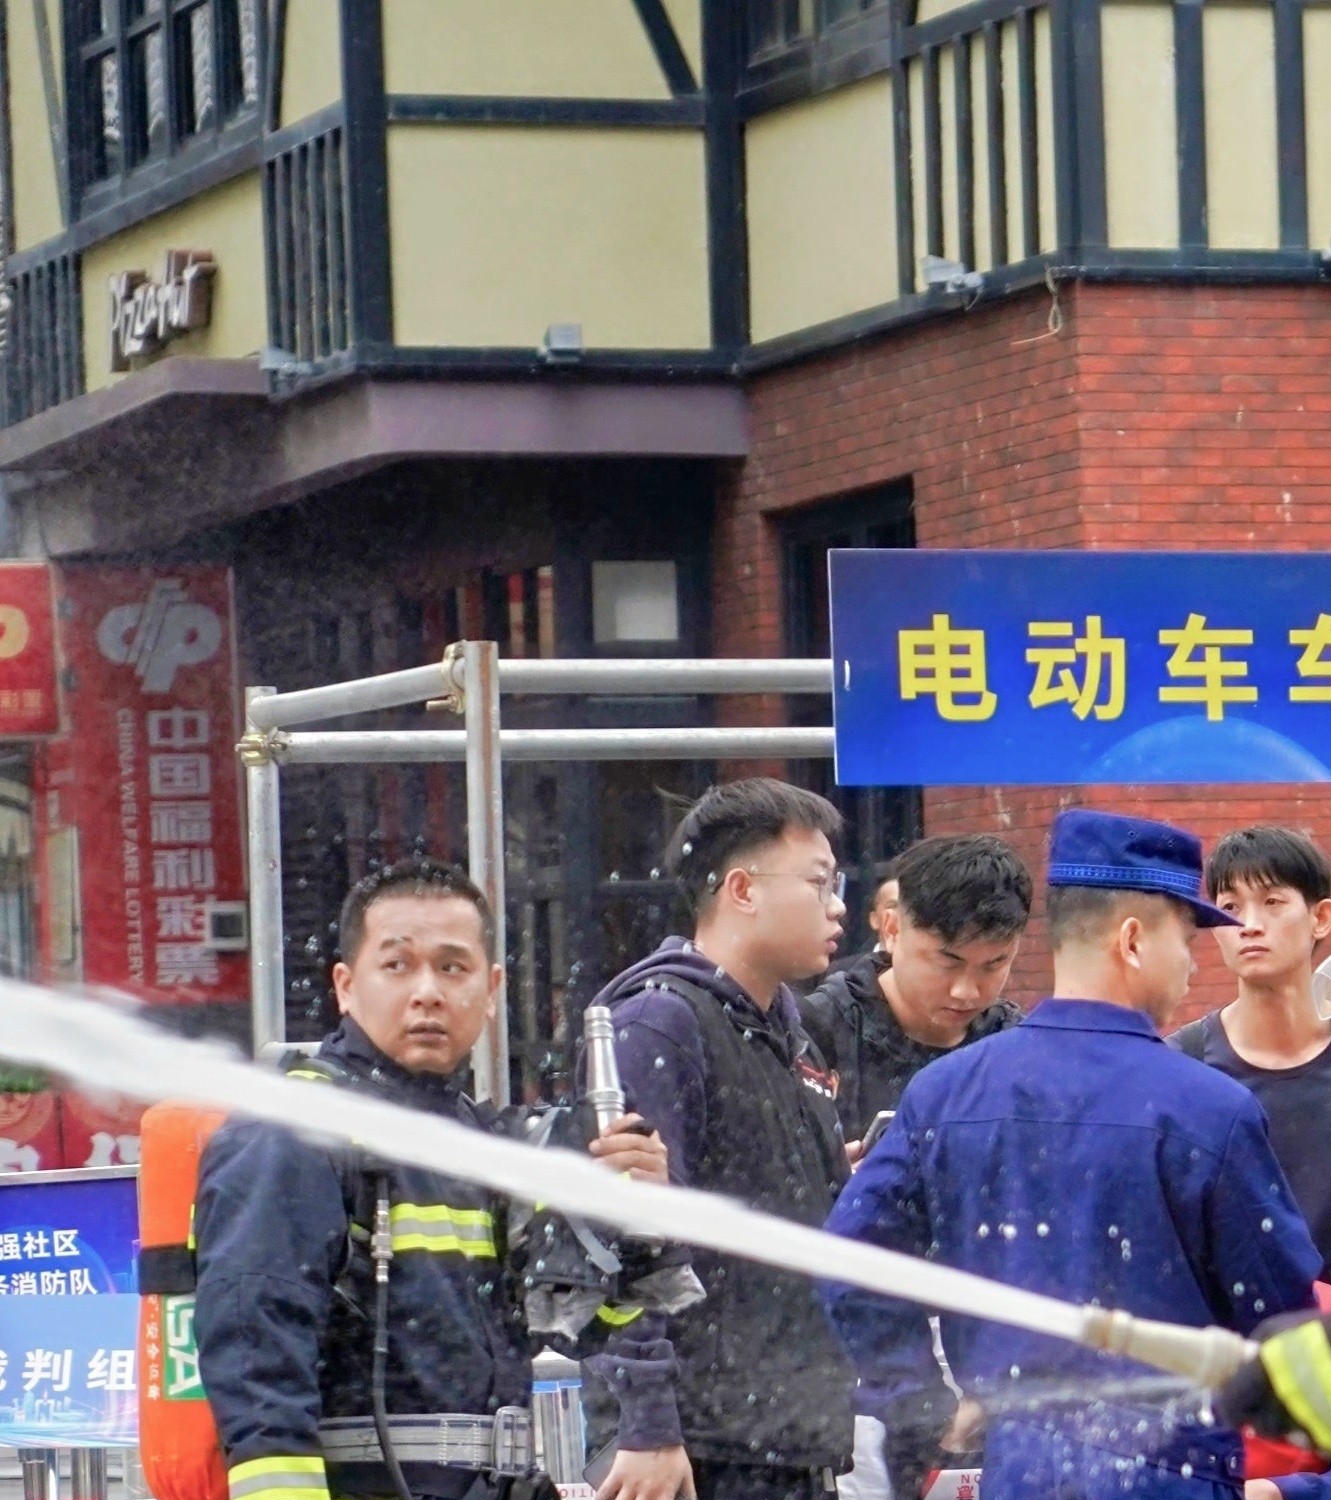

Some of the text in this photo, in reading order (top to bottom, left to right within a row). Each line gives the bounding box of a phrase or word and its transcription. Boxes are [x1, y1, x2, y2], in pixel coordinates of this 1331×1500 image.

[117, 708, 136, 777] CHINA
[120, 780, 141, 888] WELFARE
[148, 706, 220, 985] 中国福利彩票
[0, 1348, 137, 1392] 判组
